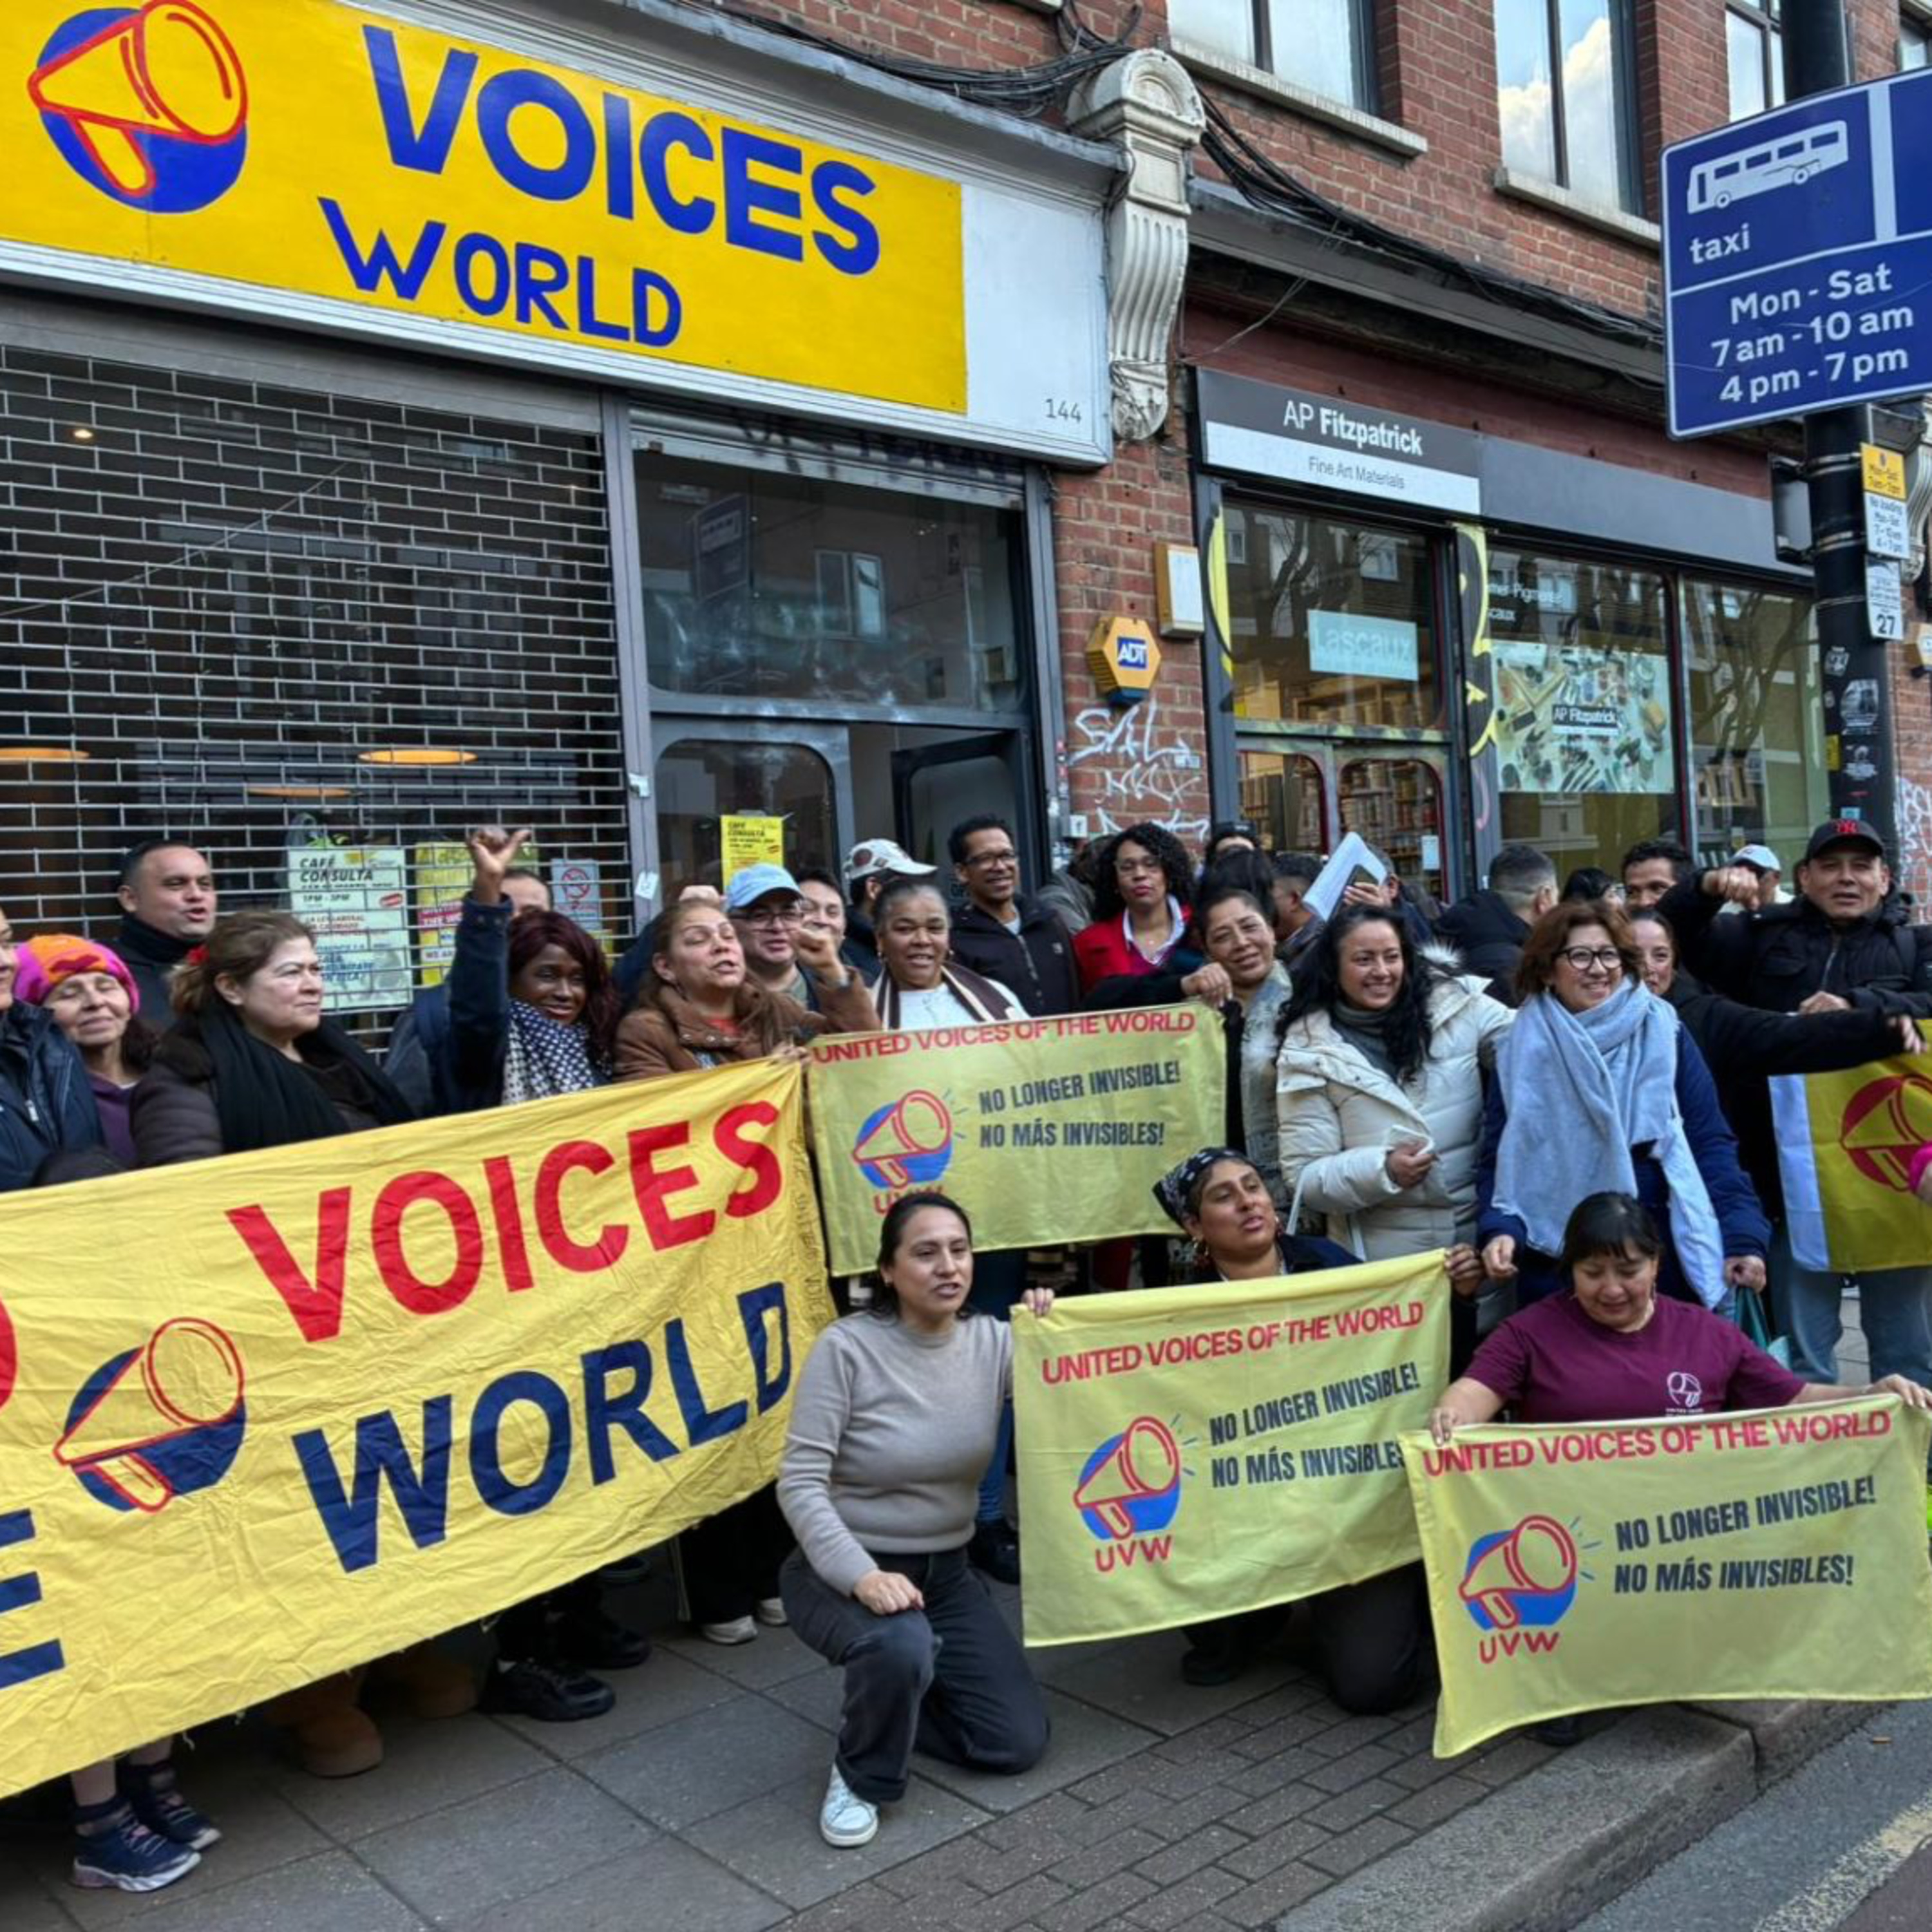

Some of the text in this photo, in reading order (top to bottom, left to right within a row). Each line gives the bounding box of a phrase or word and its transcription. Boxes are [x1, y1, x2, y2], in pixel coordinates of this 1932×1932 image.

[363, 24, 880, 275] VOICES
[1689, 223, 1750, 264] taxi
[317, 197, 681, 348] WORLD
[1730, 288, 1801, 324] Mon
[1828, 263, 1893, 299] Sat
[1045, 398, 1081, 423] 144
[1283, 400, 1423, 456] AP Fitzpatrick
[1309, 456, 1405, 489] Fine Art Materials
[1314, 625, 1411, 661] Lascaux
[1877, 614, 1895, 635] 27
[1118, 644, 1148, 665] ADT
[300, 854, 336, 868] CAFÉ
[300, 870, 373, 883] CONSULTA
[813, 1012, 1195, 1065] UNITED VOICES OF THE WORLD
[979, 1060, 1180, 1114] NO LONGER INVISIBLE!
[980, 1119, 1164, 1148] NO MÁS INVISIBLES!
[225, 1099, 784, 1343] VOICES
[1042, 1302, 1424, 1384] UNITED VOICES OF THE WORLD
[1209, 1361, 1421, 1446] NO LONGER INVISIBLE!
[290, 1281, 793, 1573] WORLD
[1424, 1410, 1891, 1477] UNITED VOICES OF THE WORLD
[1212, 1458, 1238, 1488] NO
[1247, 1446, 1296, 1484] MÁS
[1615, 1475, 1877, 1552] NO LONGER INVISIBLE!
[1095, 1535, 1172, 1573] UVW
[1614, 1555, 1854, 1594] NO MÁS INVISIBLES!
[1479, 1631, 1560, 1664] UVW
